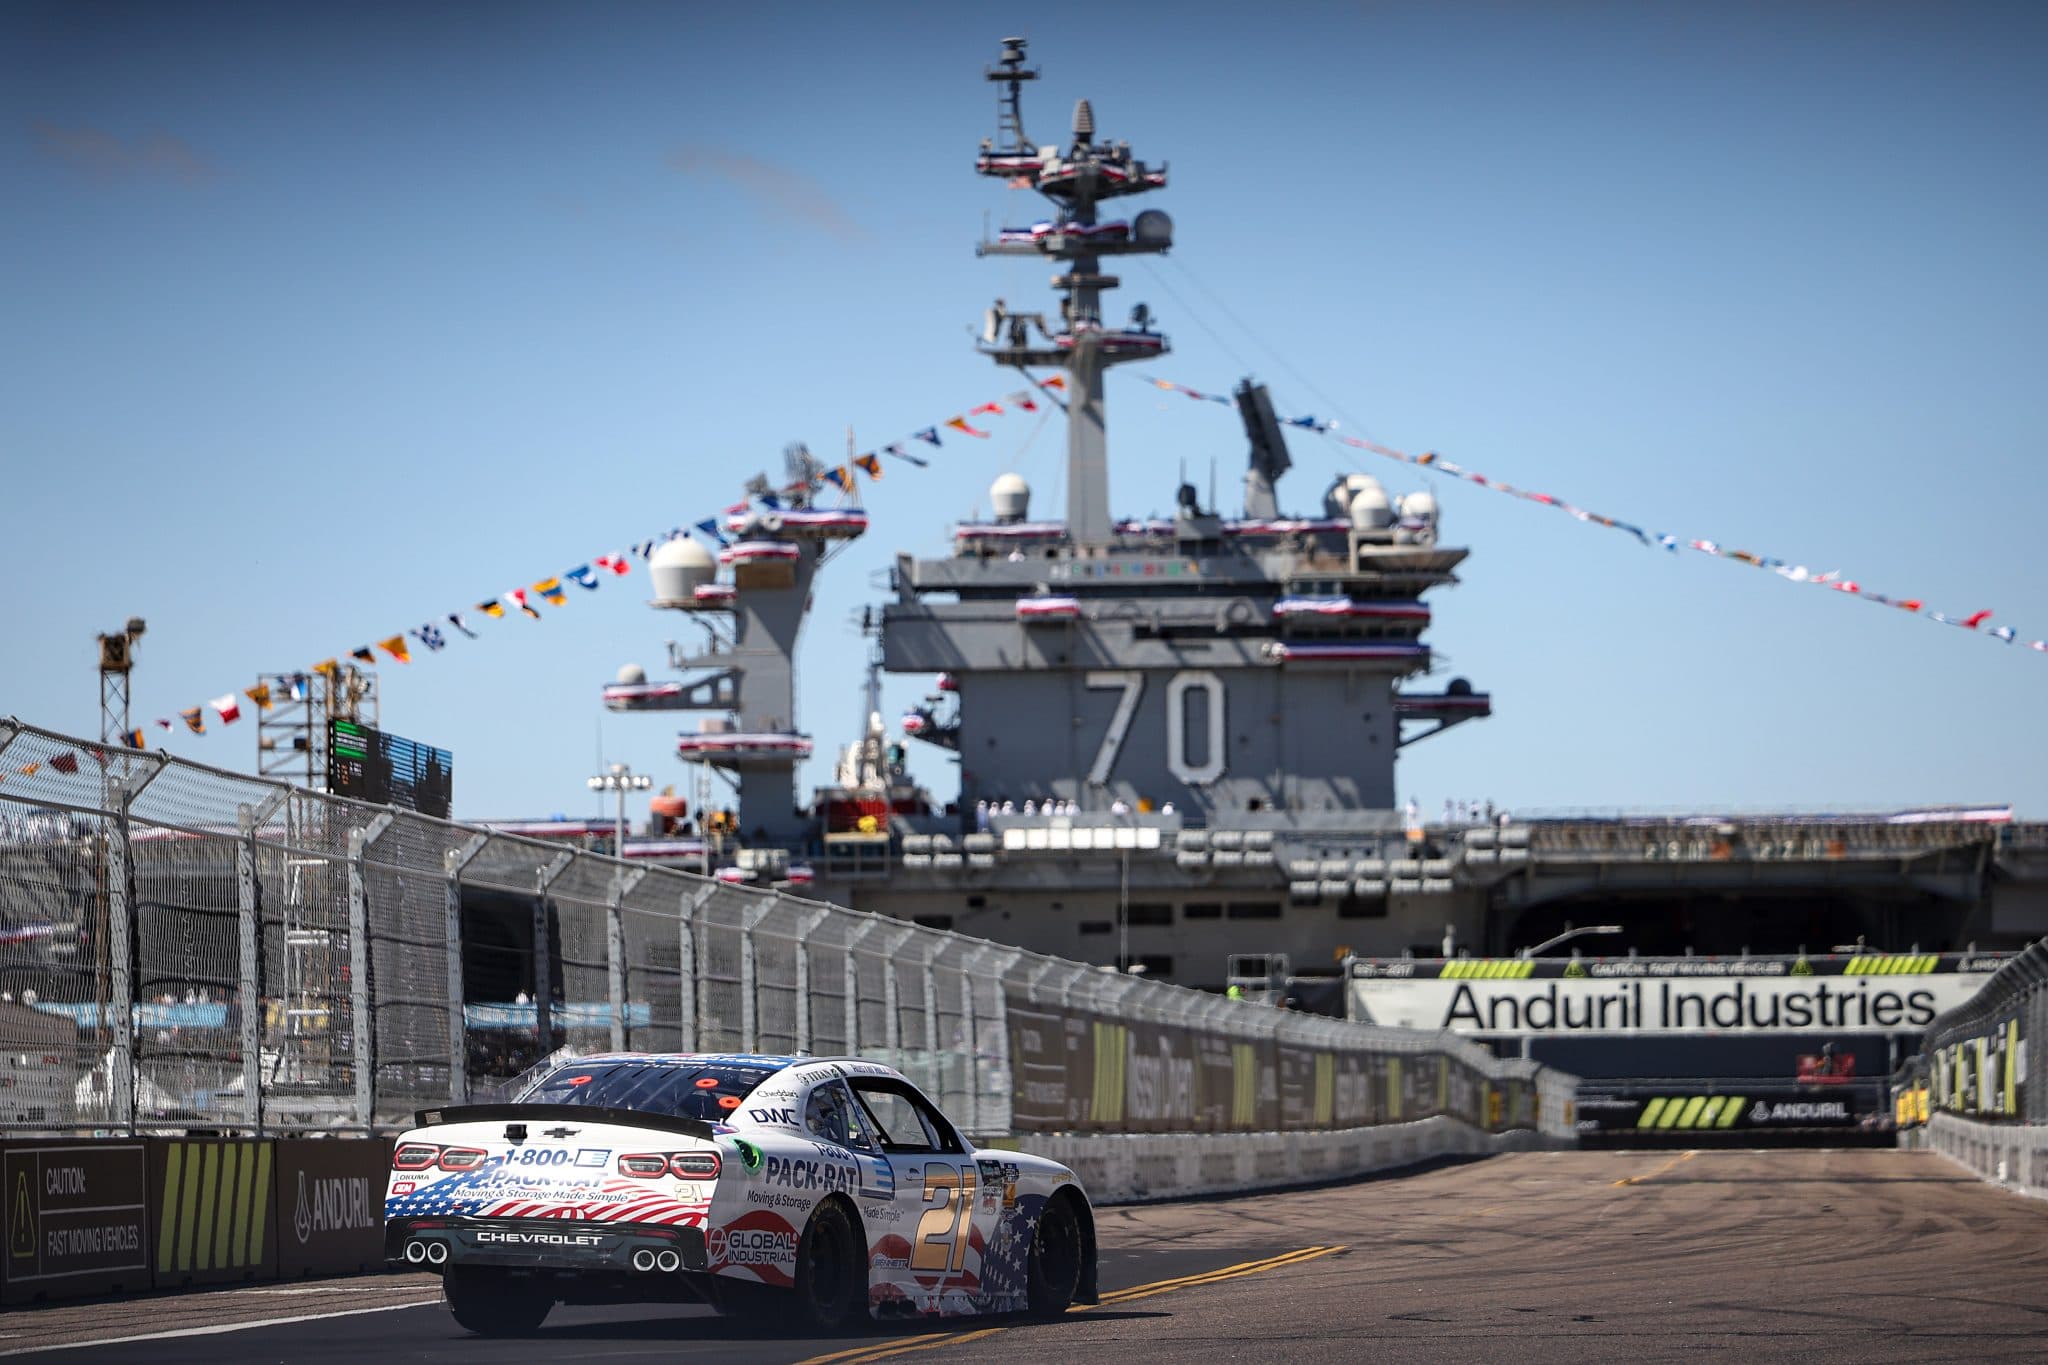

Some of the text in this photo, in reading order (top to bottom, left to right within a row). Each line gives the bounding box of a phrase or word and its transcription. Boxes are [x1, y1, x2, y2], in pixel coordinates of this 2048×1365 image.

[1085, 670, 1226, 786] 70
[1443, 979, 1937, 1030] Anduril Industries
[749, 1109, 800, 1126] DWC
[1771, 1102, 1850, 1119] ANDURIL
[313, 1177, 375, 1231] ANDURIL
[454, 1188, 628, 1202] Moving & Storage Made Simple
[747, 1190, 775, 1209] Moving
[774, 1195, 781, 1207] &
[782, 1195, 811, 1212] Storage
[909, 1162, 977, 1272] 21
[48, 1223, 139, 1256] FAST MOVING VEHICLES
[477, 1232, 603, 1246] CHEVROLET
[729, 1232, 795, 1250] GLOBAL
[729, 1249, 794, 1263] INDUSTRIAL
